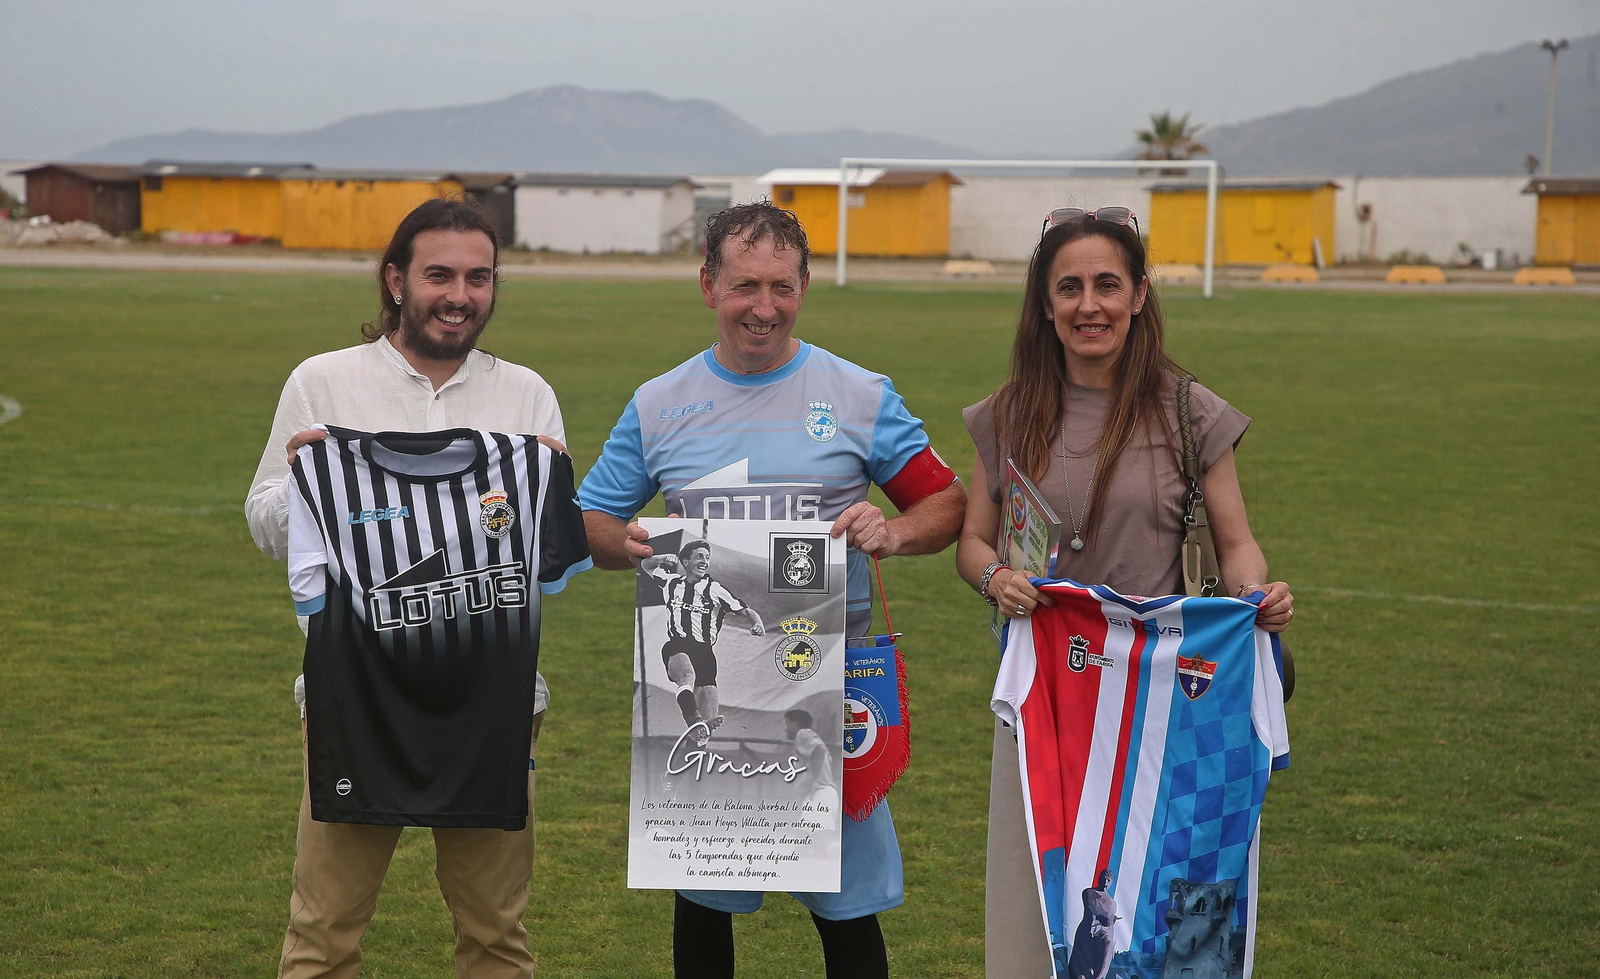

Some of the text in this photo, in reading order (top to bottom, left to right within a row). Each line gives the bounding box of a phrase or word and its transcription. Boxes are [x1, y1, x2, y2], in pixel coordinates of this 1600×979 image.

[660, 400, 714, 420] LEGEA
[348, 505, 410, 525] LEGEA
[369, 574, 526, 632] LOTUS
[844, 667, 886, 679] ARIFA
[666, 721, 807, 782] Gracias
[641, 797, 655, 811] Los
[658, 798, 696, 810] veteranos
[699, 799, 709, 810] de
[711, 799, 721, 810] la
[723, 798, 754, 812] Balona
[792, 800, 800, 812] le
[802, 801, 814, 812] da
[816, 801, 830, 813] las
[645, 817, 676, 830] gracias
[688, 814, 712, 828] Juan
[715, 814, 738, 832] Hoyos
[741, 815, 771, 829] Villalta
[773, 821, 789, 832] por
[652, 831, 690, 848] honradez
[693, 836, 699, 848] y
[740, 833, 776, 848] ofrecidos
[779, 833, 813, 846] durante
[669, 848, 800, 865] las 5 temporadas que defendió
[686, 865, 781, 882] la camiseta albinegra.
